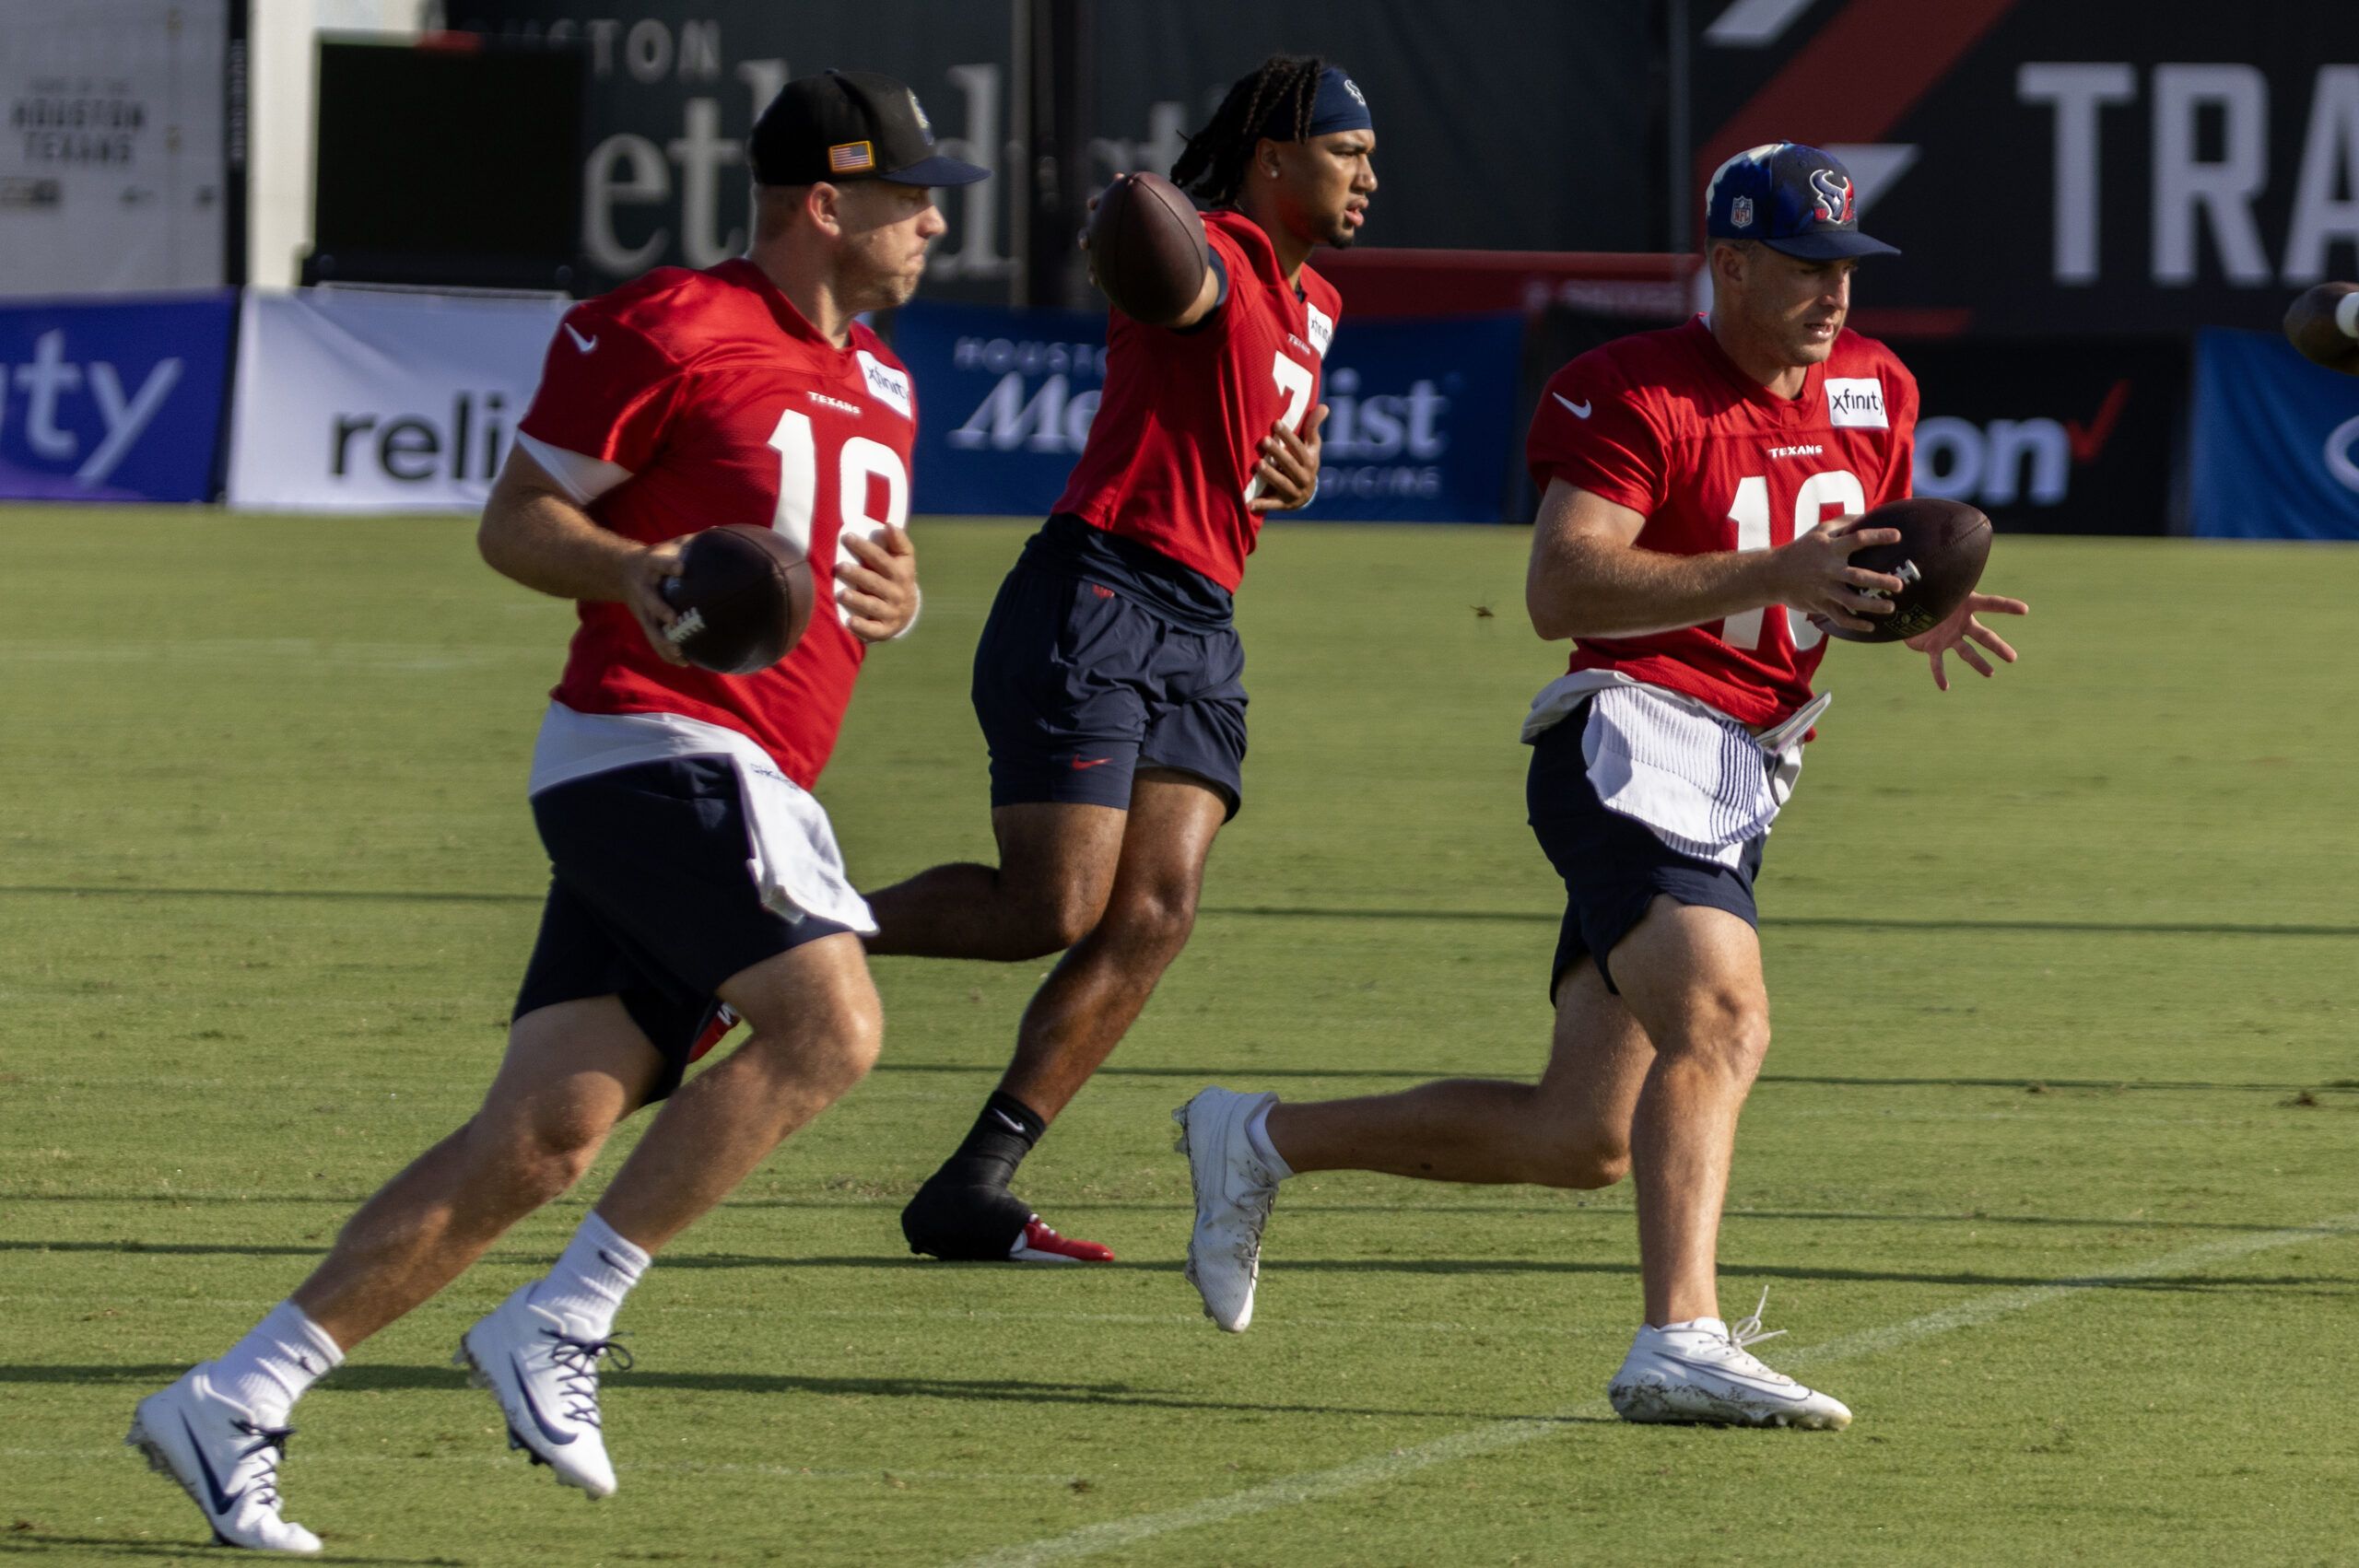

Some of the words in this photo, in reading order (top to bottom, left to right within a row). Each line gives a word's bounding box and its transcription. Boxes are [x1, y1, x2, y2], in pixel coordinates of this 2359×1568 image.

[804, 391, 863, 415] TEXANS
[1244, 350, 1313, 505] 7
[1767, 444, 1824, 460] TEXANS
